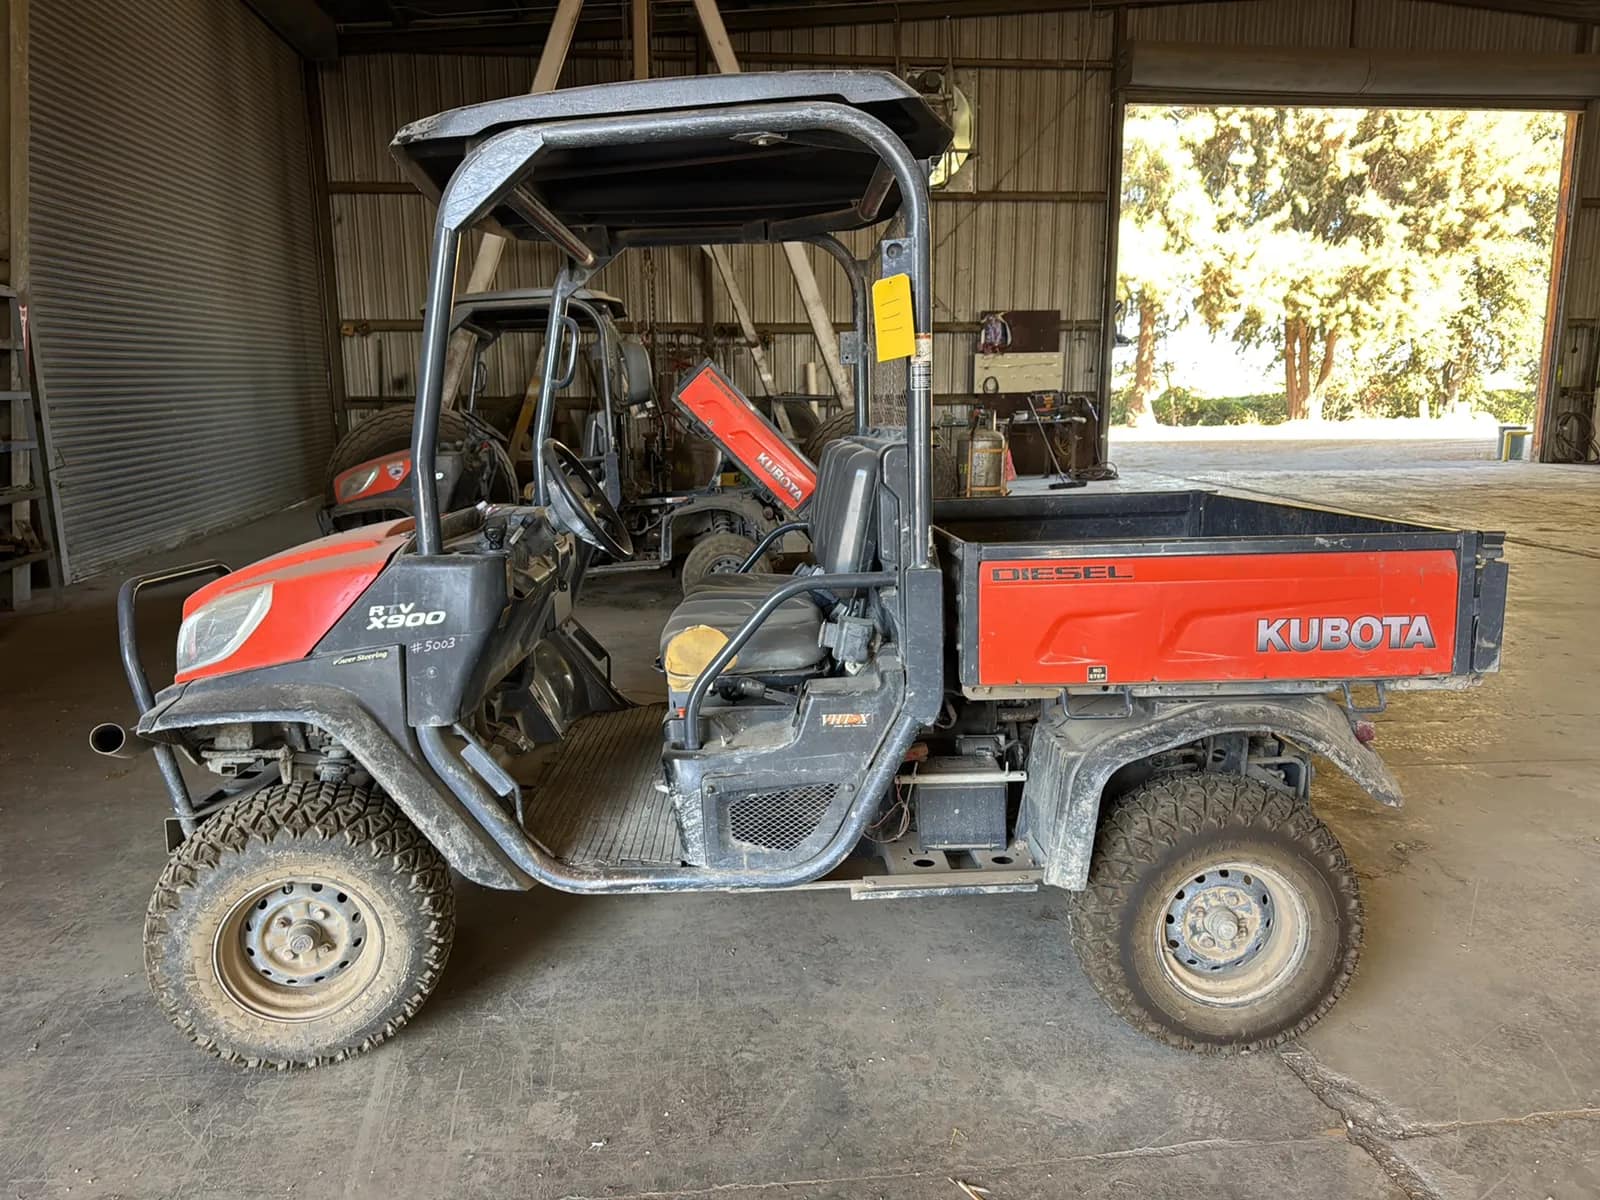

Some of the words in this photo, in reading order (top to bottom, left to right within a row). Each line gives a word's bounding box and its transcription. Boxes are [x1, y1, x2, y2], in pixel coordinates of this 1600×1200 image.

[755, 451, 804, 501] KUBOTA
[992, 565, 1134, 582] DIESEL
[368, 602, 415, 617] RTV
[366, 611, 446, 630] X900
[1256, 615, 1436, 653] KUBOTA
[410, 636, 456, 654] #5003
